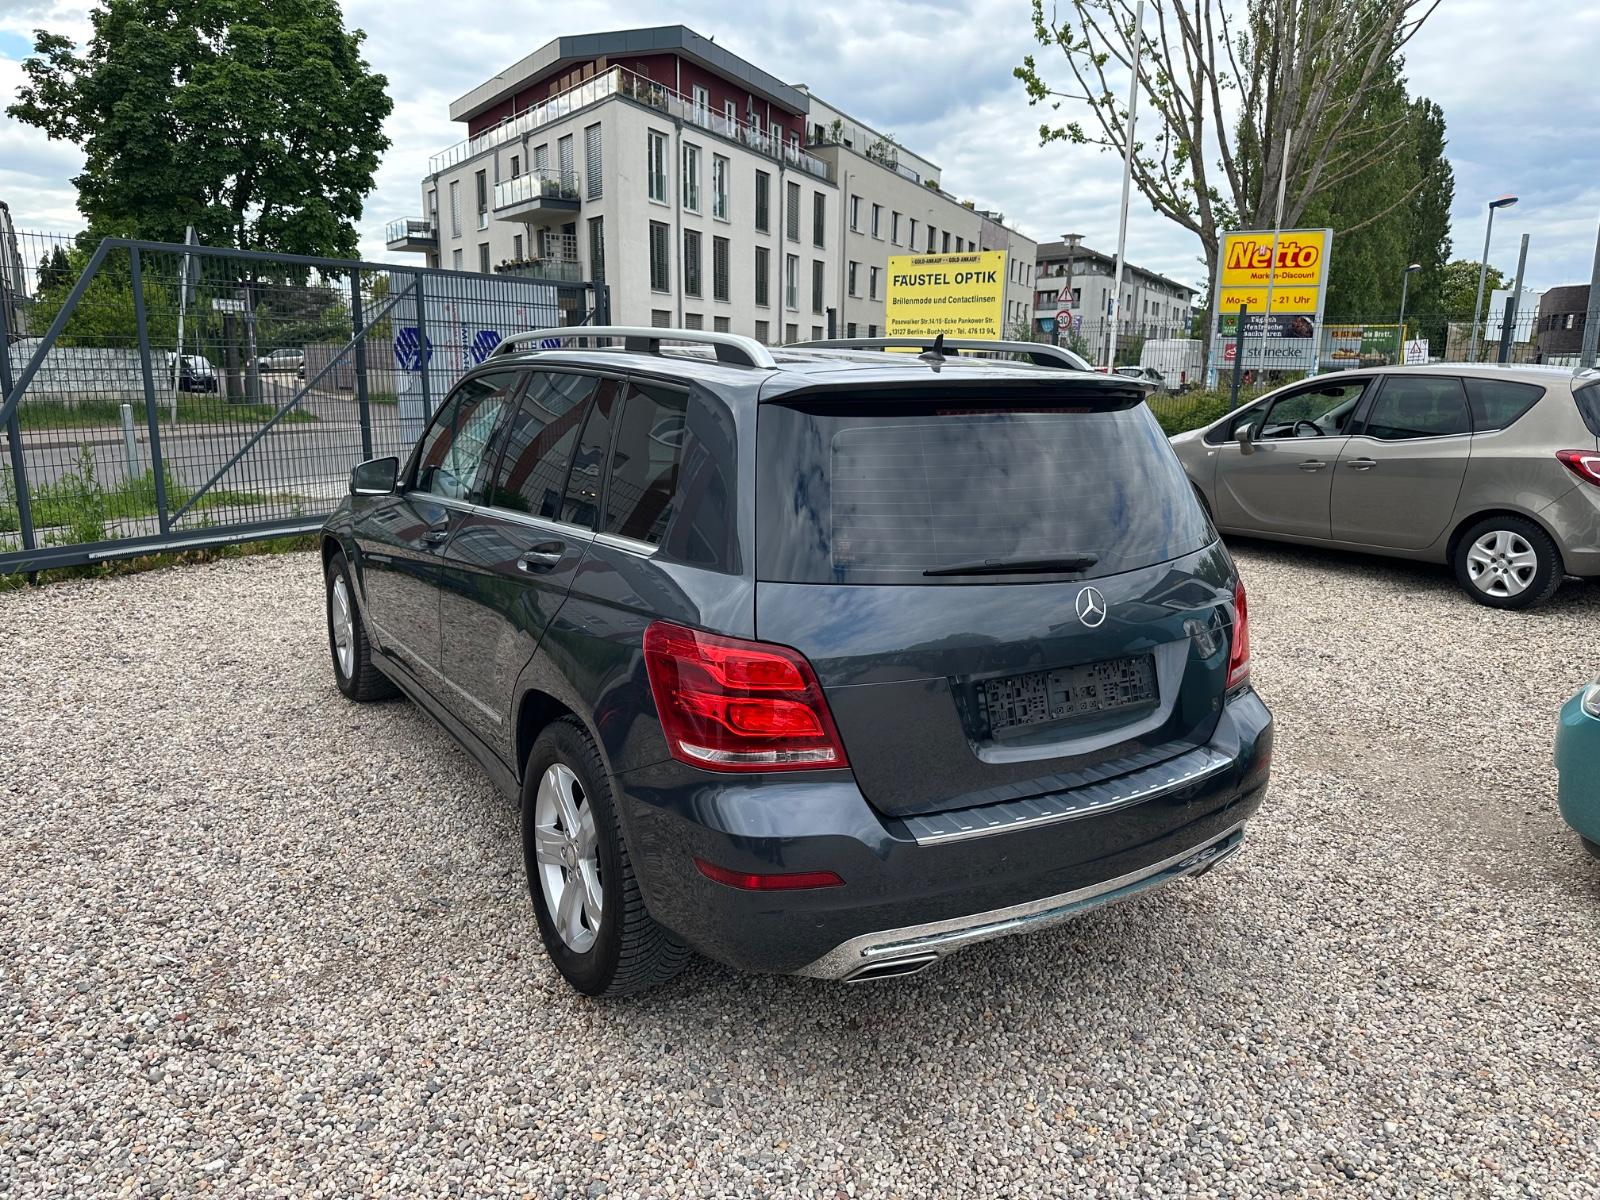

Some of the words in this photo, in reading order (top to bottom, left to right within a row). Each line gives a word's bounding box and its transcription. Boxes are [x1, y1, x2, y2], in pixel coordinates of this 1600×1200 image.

[1227, 241, 1319, 269] Netto
[893, 273, 951, 287] FÄUSTEL
[954, 270, 997, 285] OPTIK
[1250, 271, 1315, 280] Markn-Discount
[892, 296, 932, 305] Brillenmode
[933, 296, 947, 304] und
[947, 294, 996, 304] Contactlinsen
[1279, 296, 1289, 304] 21
[1294, 295, 1311, 304] Uhr
[1059, 315, 1068, 325] 30
[1250, 315, 1277, 324] Tägch
[1248, 346, 1302, 357] steinecke
